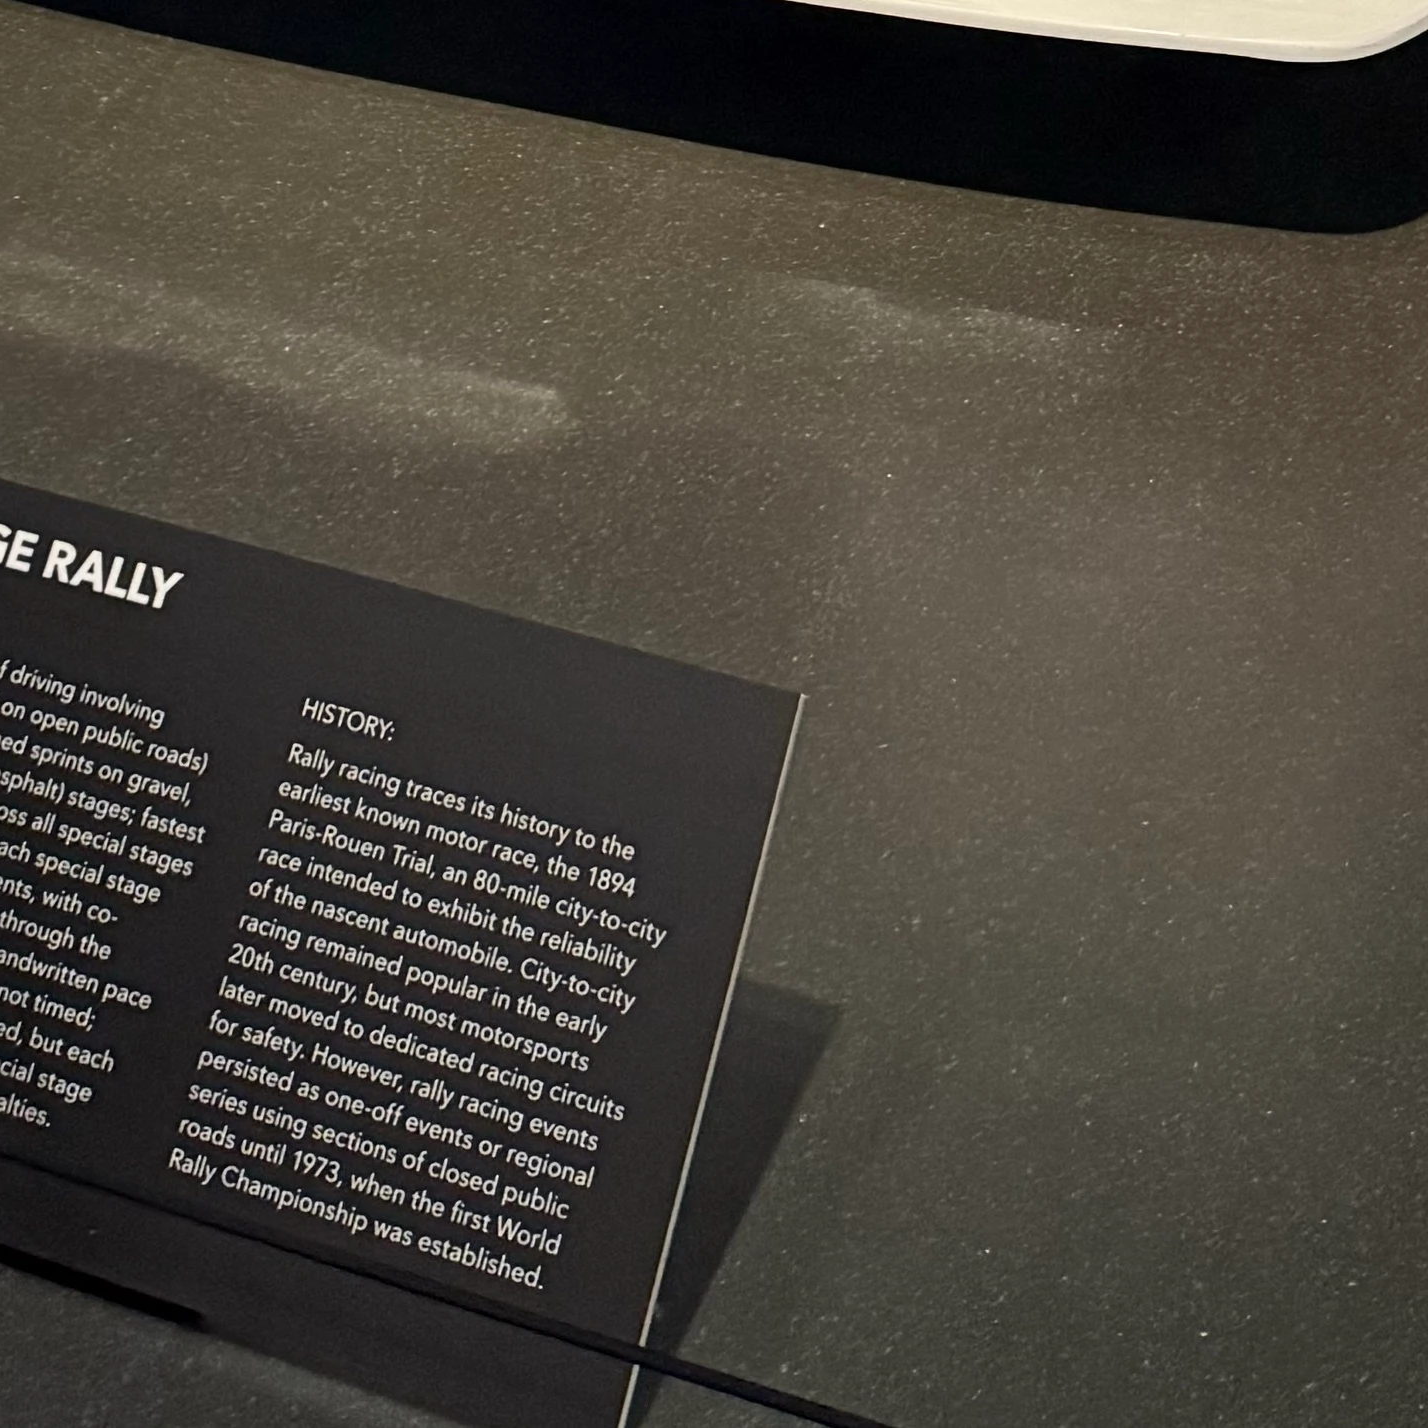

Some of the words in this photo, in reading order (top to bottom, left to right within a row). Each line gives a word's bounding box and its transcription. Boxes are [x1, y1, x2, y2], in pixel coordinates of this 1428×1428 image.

[42, 539, 184, 610] RALLY
[9, 664, 76, 704] driving
[79, 683, 165, 730] involving
[302, 697, 395, 742] HISTORY:
[31, 813, 56, 834] all
[57, 823, 127, 856] special
[128, 844, 193, 876] stages
[66, 790, 136, 826] stages;
[140, 805, 206, 844] fastest
[278, 781, 352, 814] earliest
[354, 796, 420, 835] known
[425, 824, 489, 854] motor
[491, 843, 539, 874] race,
[547, 854, 580, 881] the
[589, 866, 636, 897] 1894
[287, 742, 335, 778] Rally
[338, 763, 401, 798] racing
[405, 779, 466, 811] traces
[470, 795, 495, 820] its
[499, 802, 571, 846] history
[575, 828, 596, 849] to
[601, 834, 635, 861] the
[42, 890, 82, 915] with
[86, 904, 118, 923] co-
[268, 808, 385, 861] Paris-Rouen
[393, 844, 435, 879] Trial,
[442, 866, 467, 886] an
[472, 869, 550, 909] 80-mile
[555, 896, 667, 949] city-to-city
[33, 993, 96, 1032] timed;
[227, 942, 274, 974] 20th
[279, 964, 357, 1004] century,
[364, 982, 401, 1013] but
[403, 1002, 457, 1031] most
[460, 1019, 589, 1071] motorsports
[238, 914, 301, 951] racing
[305, 935, 403, 976] remained
[404, 965, 488, 1001] popular
[491, 986, 511, 1010] in
[516, 994, 550, 1022] the
[555, 1011, 608, 1043] early
[208, 1009, 239, 1036] for
[241, 1026, 304, 1062] safety.
[311, 1042, 403, 1093] However,
[409, 1078, 455, 1110] rally
[458, 1095, 524, 1133] racing
[529, 1117, 598, 1151] events
[168, 1147, 217, 1184] Rally
[221, 1165, 368, 1231] Championship
[374, 1220, 413, 1246] was
[417, 1236, 543, 1289] established.
[178, 1119, 236, 1149] roads
[240, 1138, 287, 1165] until
[293, 1150, 342, 1188] 1973,
[350, 1172, 405, 1205] when
[411, 1189, 445, 1217] the
[450, 1199, 491, 1233] first
[497, 1215, 562, 1255] World
